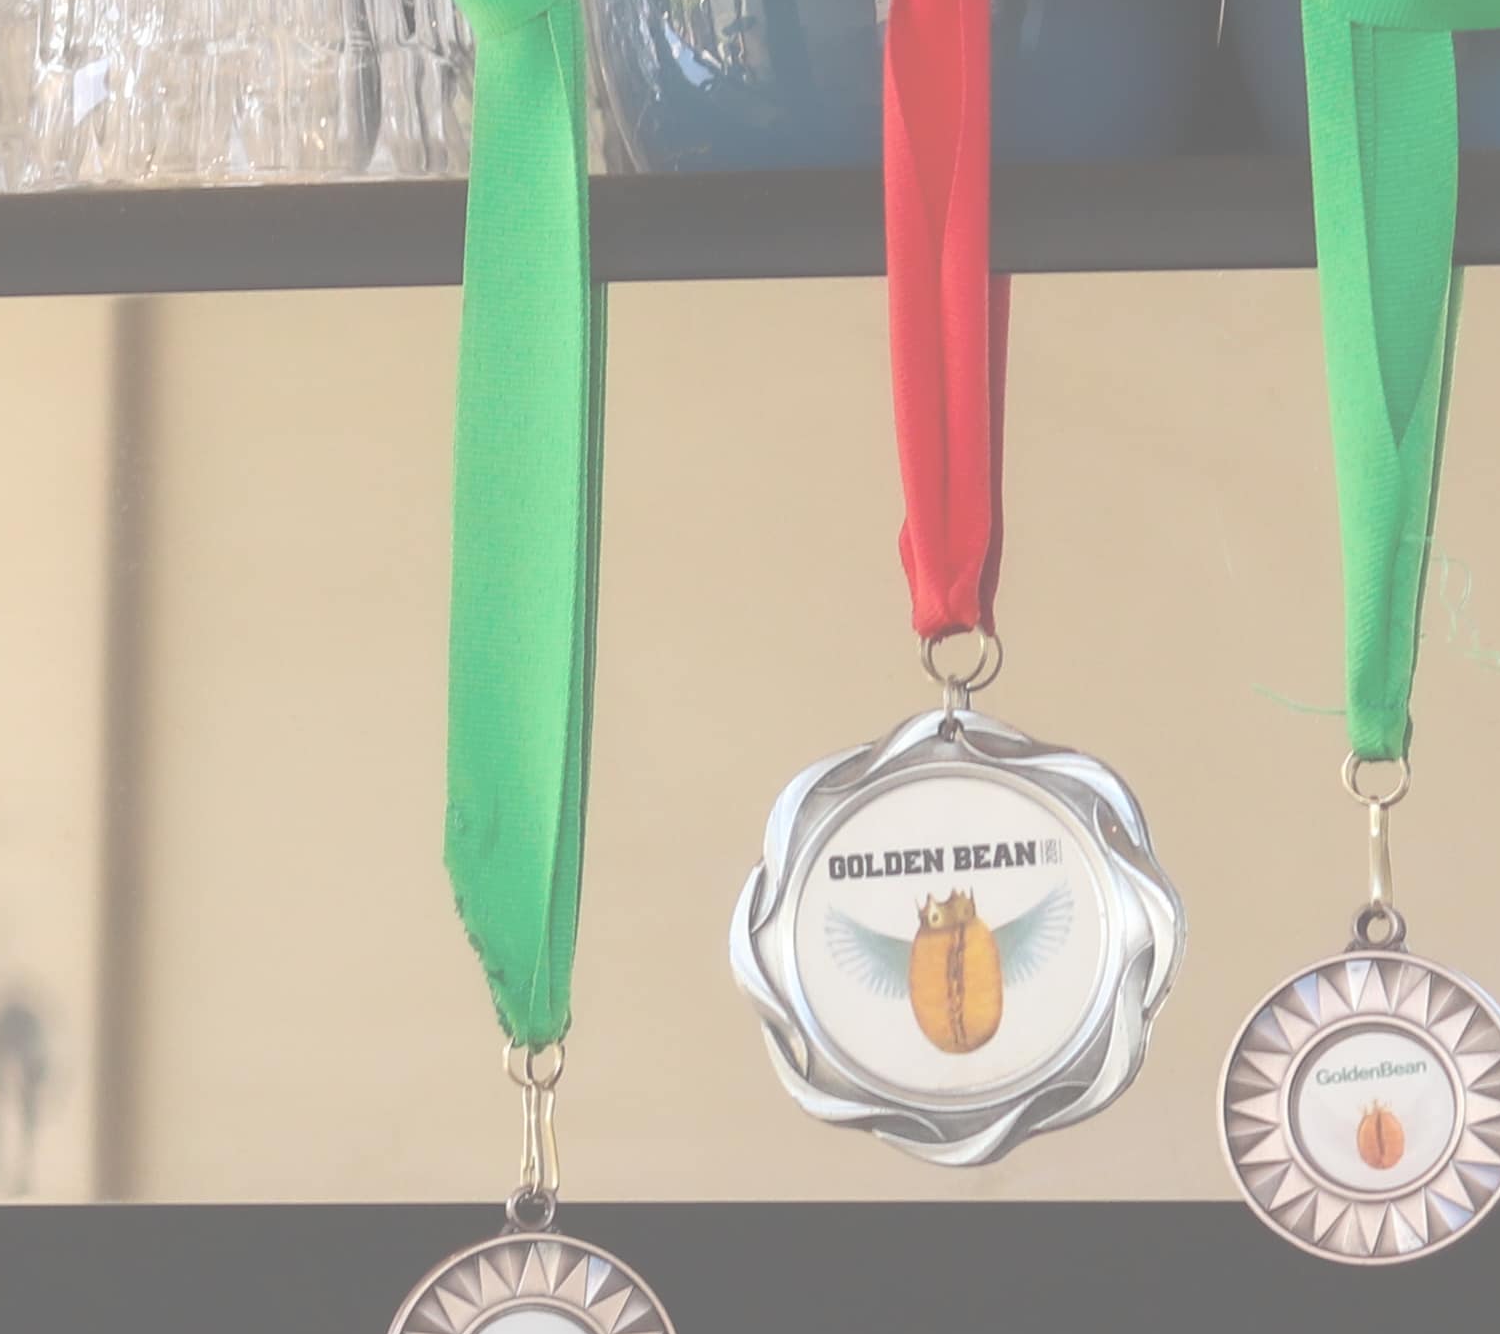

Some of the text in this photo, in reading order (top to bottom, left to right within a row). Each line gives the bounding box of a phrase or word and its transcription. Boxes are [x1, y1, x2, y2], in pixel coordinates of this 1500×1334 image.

[829, 849, 944, 880] GOLDEN
[954, 841, 1037, 870] BEAN
[1316, 1060, 1426, 1085] GoldenBean
